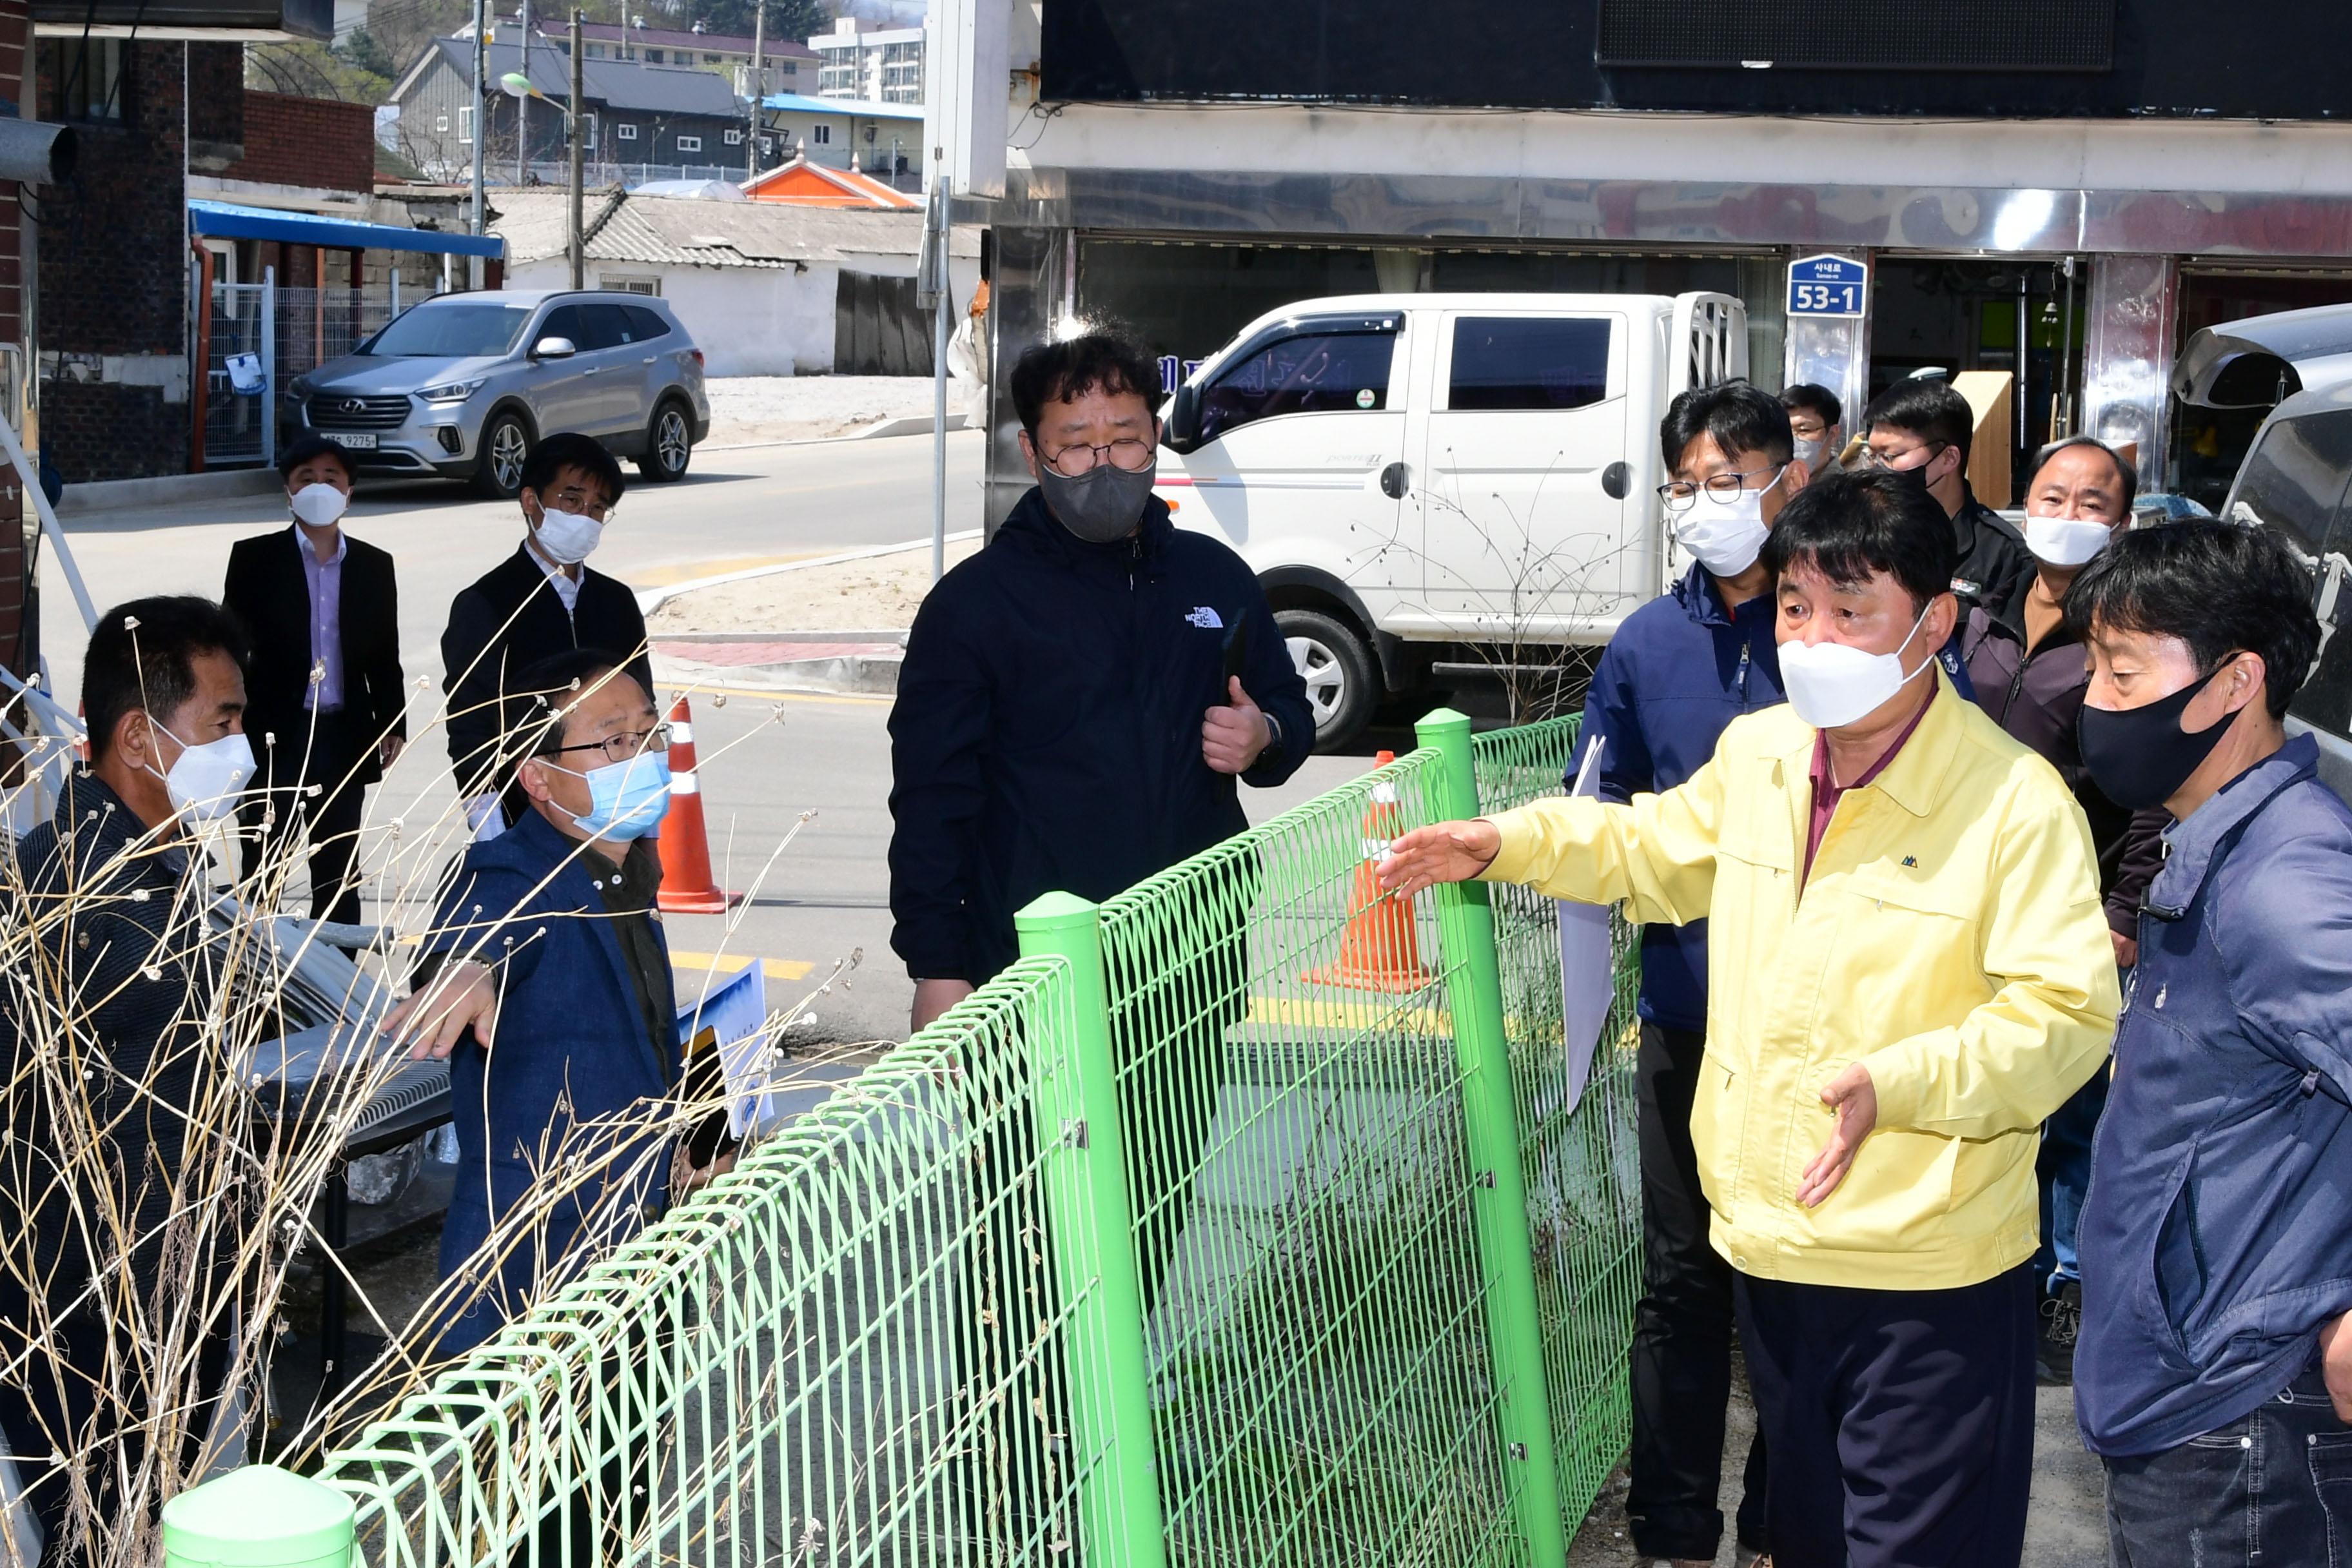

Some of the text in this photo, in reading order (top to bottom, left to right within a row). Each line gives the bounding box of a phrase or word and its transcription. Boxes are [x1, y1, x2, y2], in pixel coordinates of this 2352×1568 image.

[1814, 263, 1841, 272] 사내로
[1797, 286, 1853, 309] 53-1
[346, 436, 371, 446] 9275
